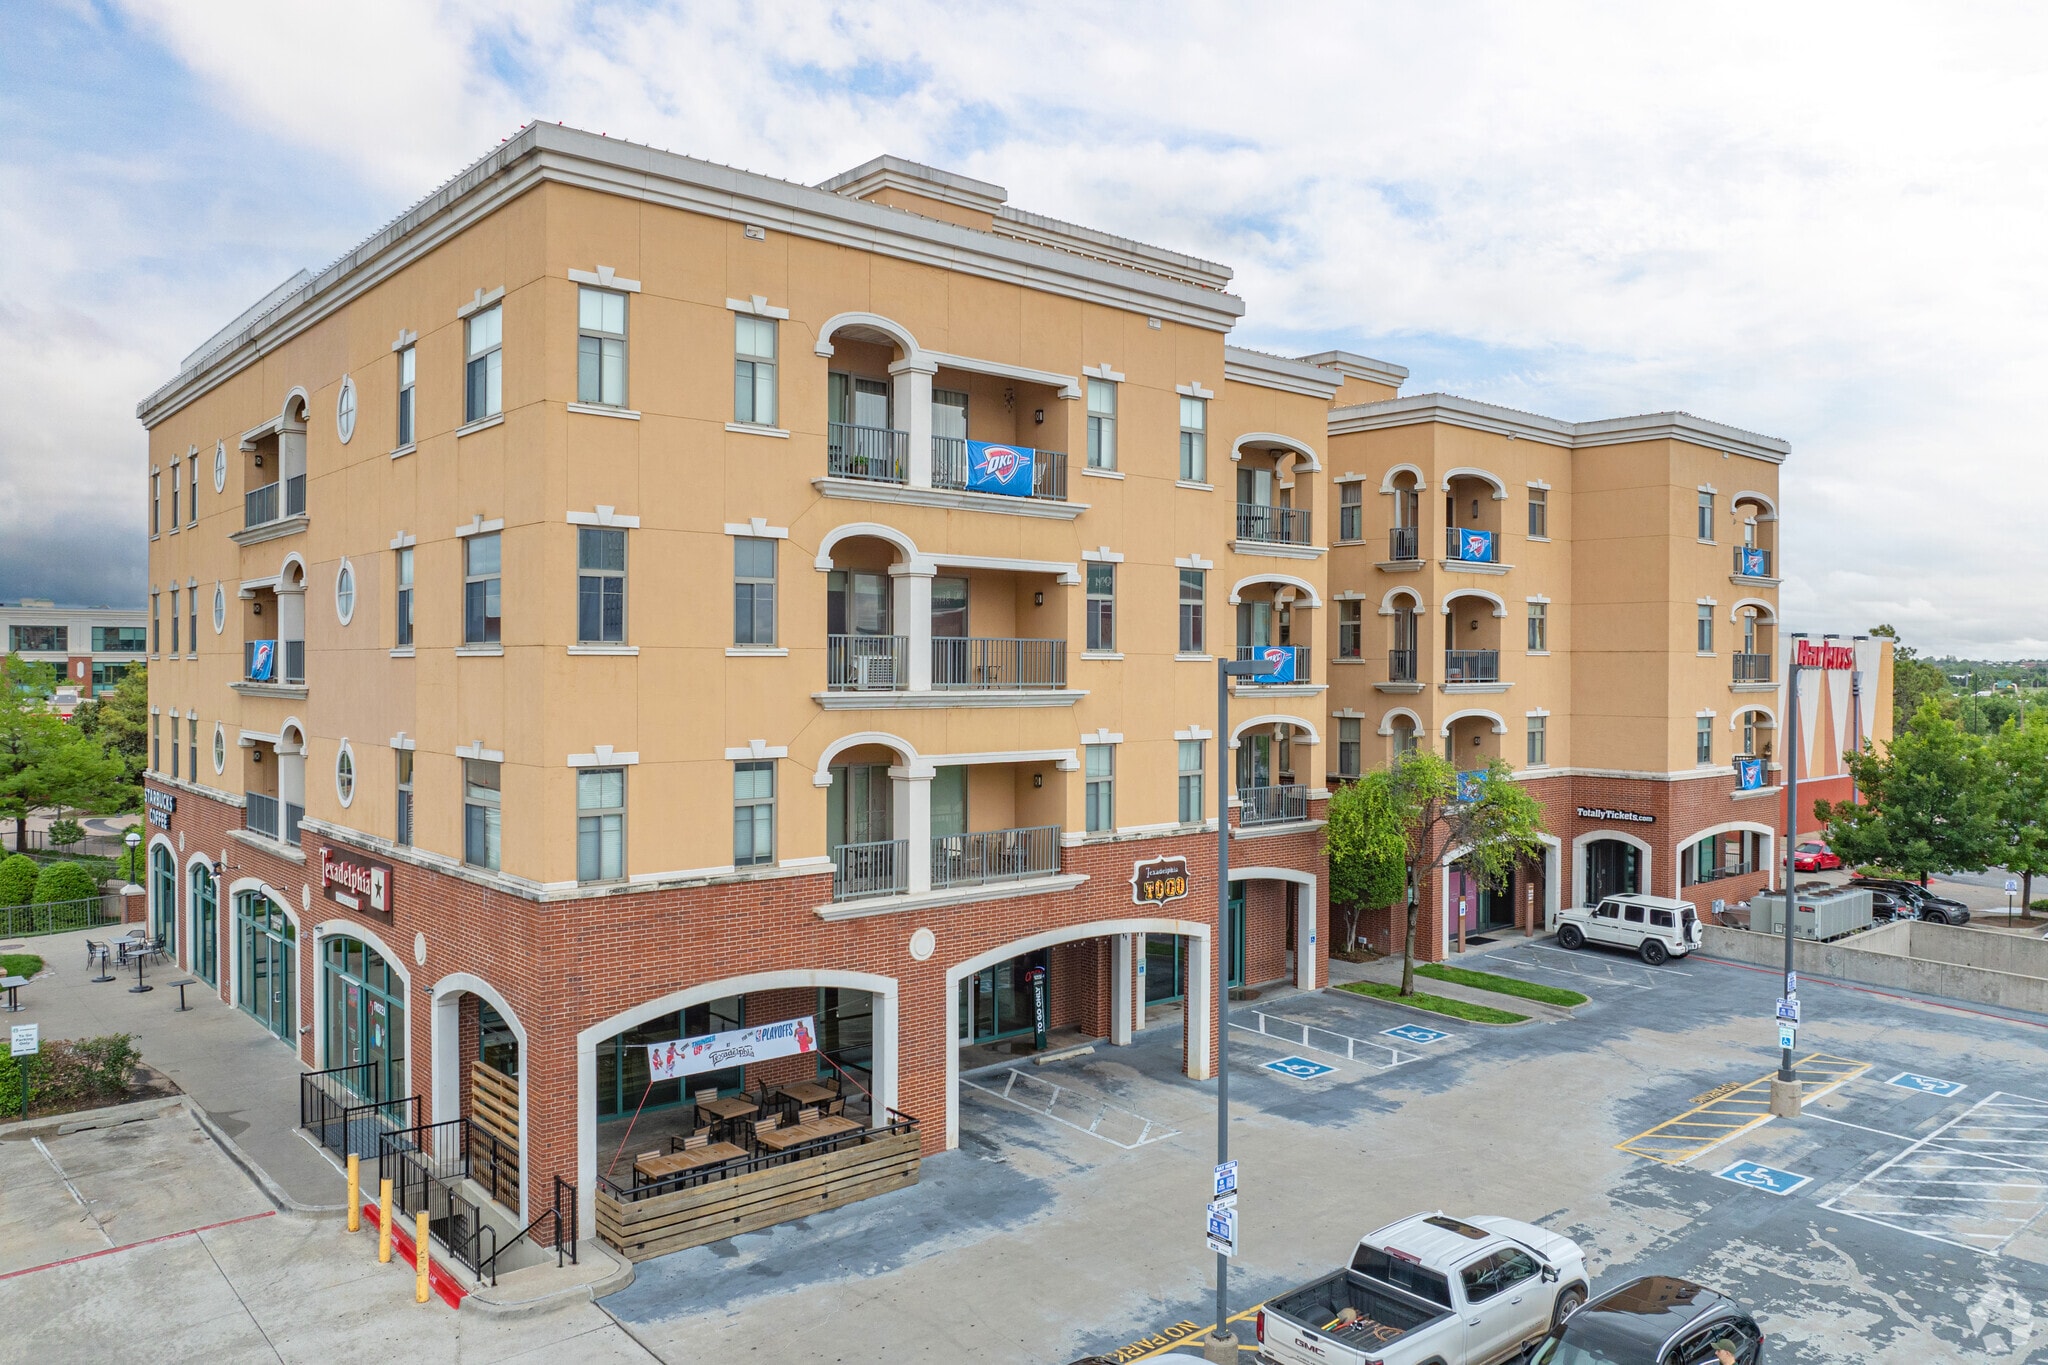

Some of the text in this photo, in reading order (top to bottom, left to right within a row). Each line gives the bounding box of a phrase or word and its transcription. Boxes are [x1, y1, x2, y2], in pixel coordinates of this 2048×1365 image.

[986, 454, 1013, 475] OKC
[1797, 640, 1852, 670] Harkins
[145, 787, 173, 812] STARBUCKS
[149, 808, 169, 830] COFFEE
[1577, 807, 1653, 822] TotallyTickets.com
[319, 847, 371, 896] Texadelphia
[1145, 866, 1179, 879] Texadelphia
[1036, 1008, 1043, 1021] GO
[761, 1022, 794, 1041] PLAYOFFS
[1037, 1022, 1043, 1034] TO
[691, 1034, 716, 1048] THUNDER
[693, 1044, 703, 1056] UP
[709, 1045, 755, 1066] Texadelphia
[1164, 1319, 1201, 1338] NO
[1295, 1338, 1326, 1358] GMC
